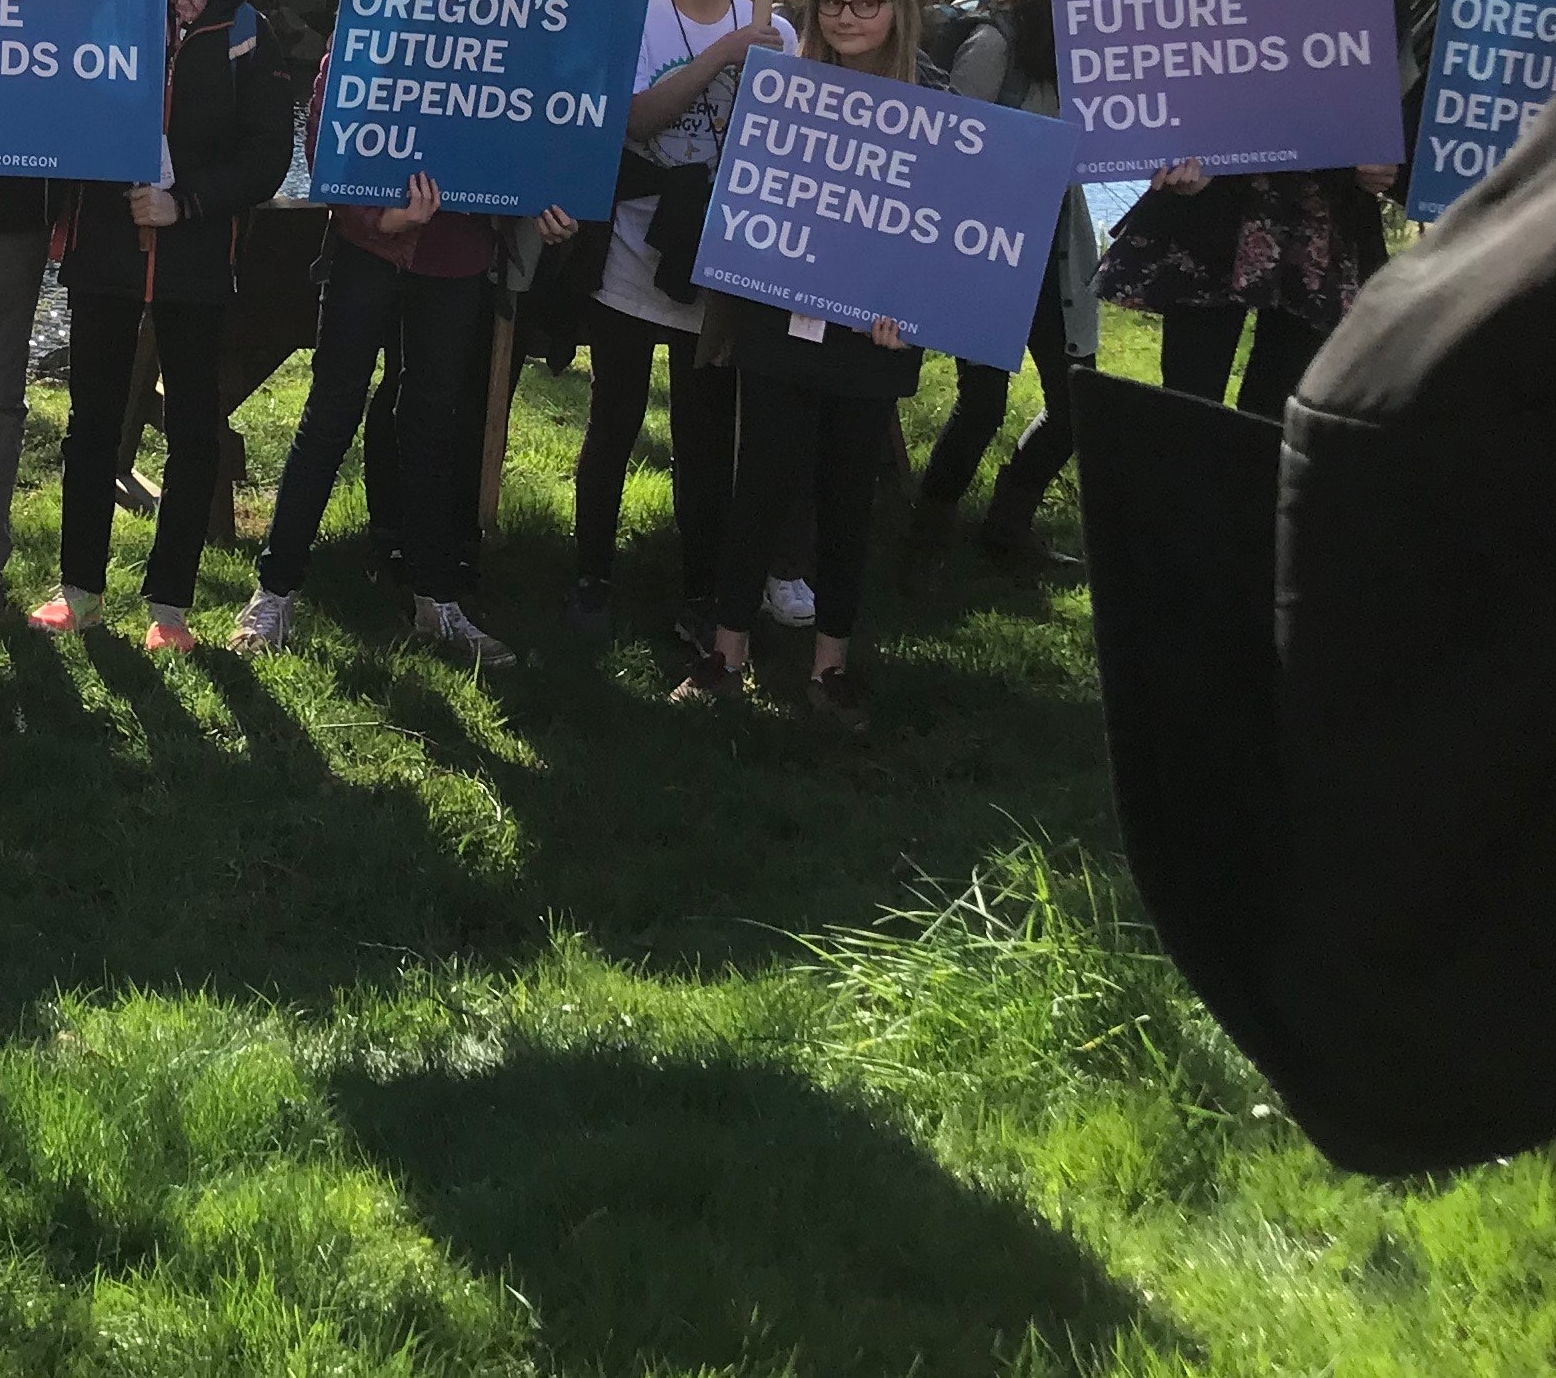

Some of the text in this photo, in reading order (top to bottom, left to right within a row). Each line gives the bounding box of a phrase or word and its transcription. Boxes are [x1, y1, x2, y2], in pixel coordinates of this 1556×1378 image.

[72, 43, 138, 81] ON
[344, 28, 507, 74] FUTURE
[1070, 29, 1371, 85] DEPENDS ON
[336, 74, 608, 129] DEPENDS ON
[752, 69, 987, 156] OREGON'S
[1072, 91, 1182, 132] YOU.
[331, 120, 423, 161] YOU.
[738, 114, 918, 189] FUTURE
[1076, 158, 1167, 174] @OECONLINE
[320, 183, 403, 199] @OECONLINE
[727, 158, 1025, 268] DEPENDS ON
[719, 203, 816, 264] YOU.
[704, 265, 792, 300] @OECONLINE
